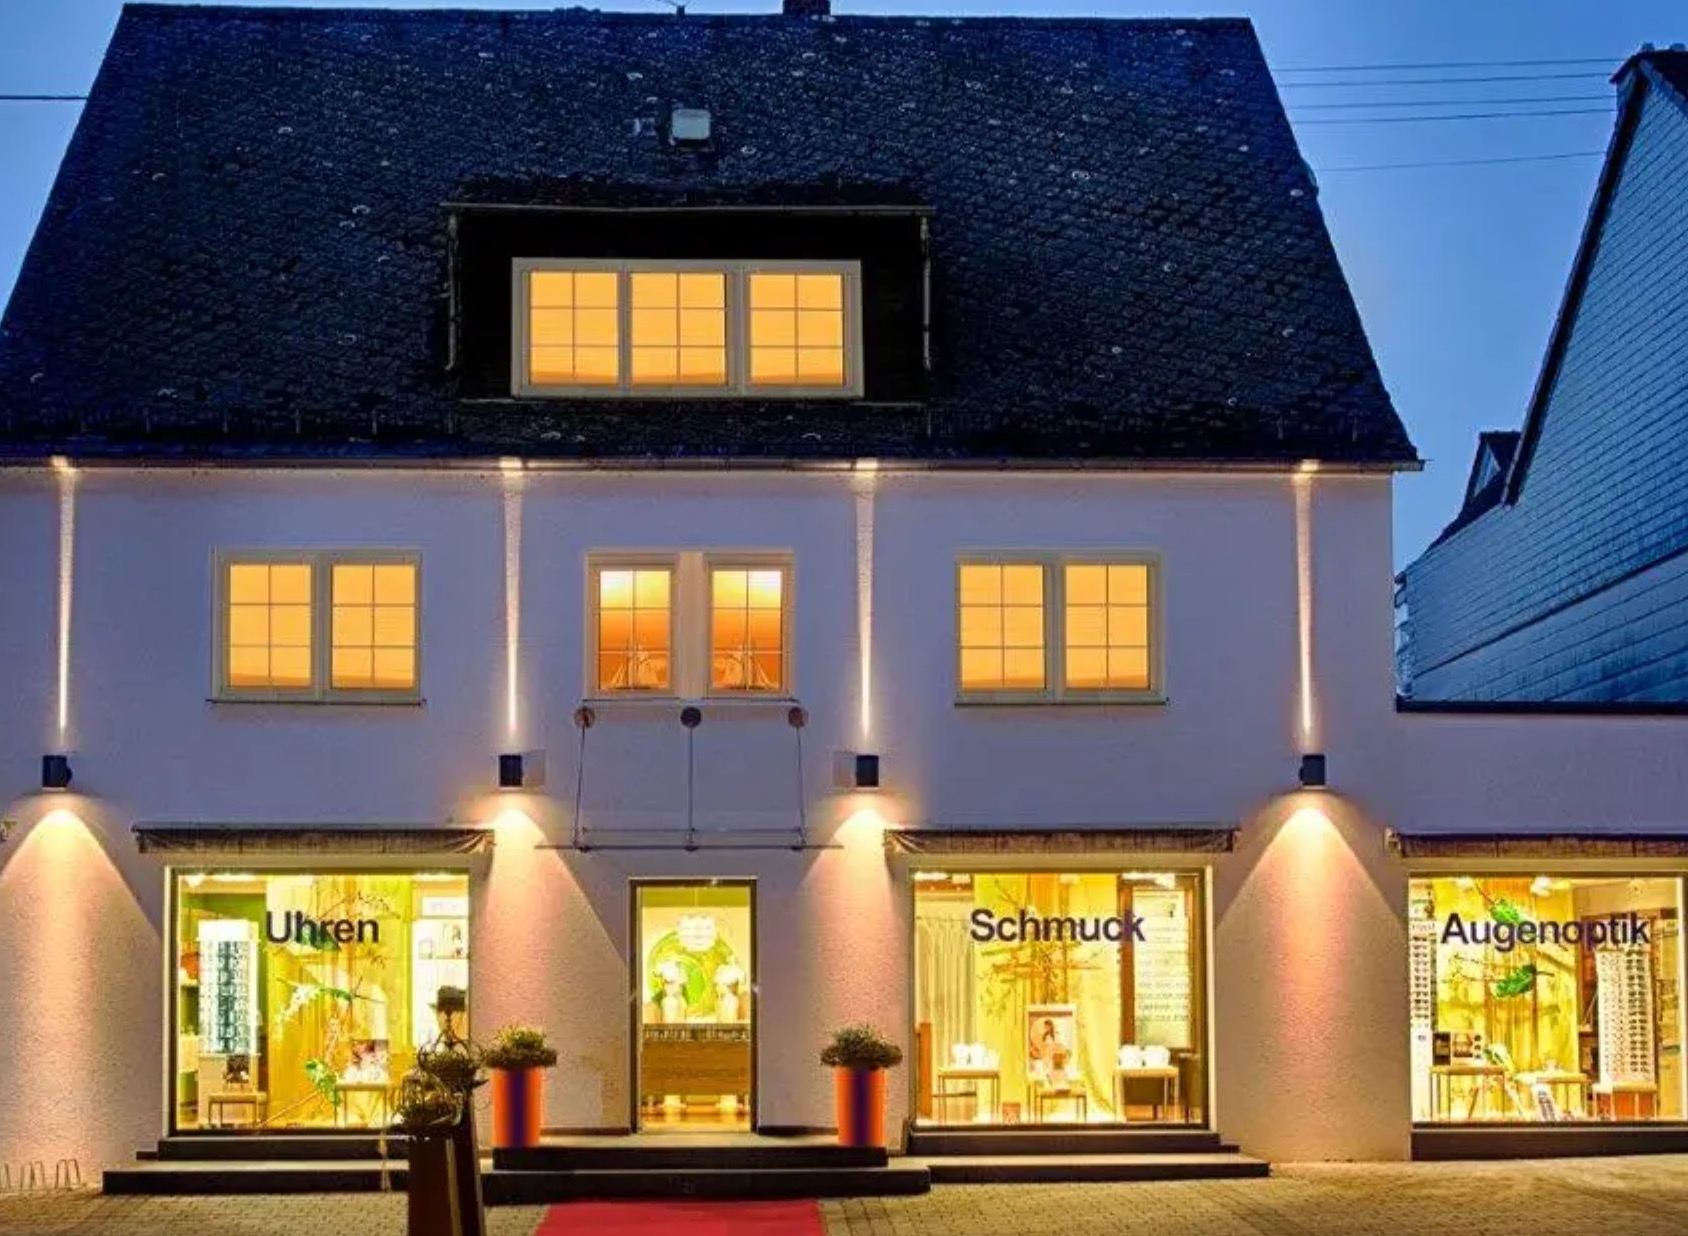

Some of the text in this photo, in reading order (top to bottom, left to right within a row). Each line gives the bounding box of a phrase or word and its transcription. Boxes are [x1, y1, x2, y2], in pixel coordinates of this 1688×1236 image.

[266, 910, 378, 943] Uhren
[970, 908, 1145, 942] Schmuck
[1441, 911, 1650, 952] Augenoptik
